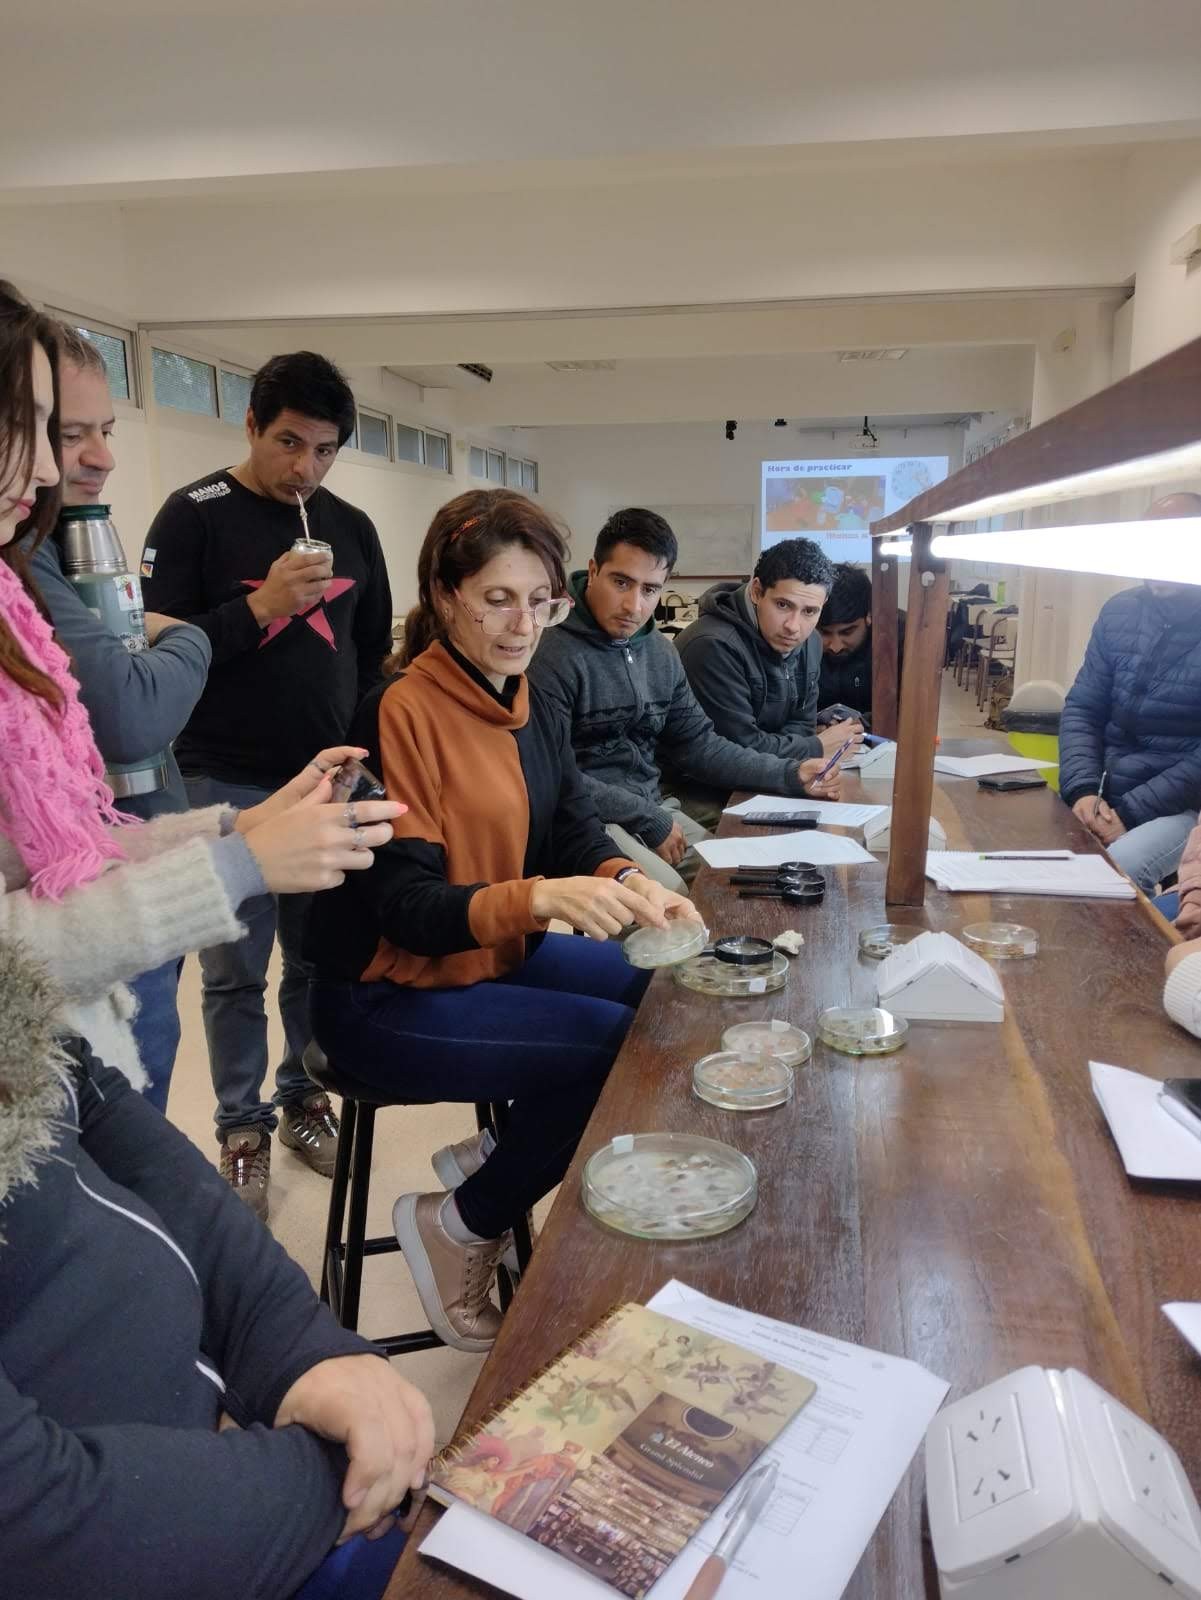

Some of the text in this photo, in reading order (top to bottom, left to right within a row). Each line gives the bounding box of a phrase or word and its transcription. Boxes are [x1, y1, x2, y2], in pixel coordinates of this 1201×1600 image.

[806, 463, 853, 473] practicar
[188, 481, 227, 500] MANOS
[664, 1437, 714, 1468] El Ateneo
